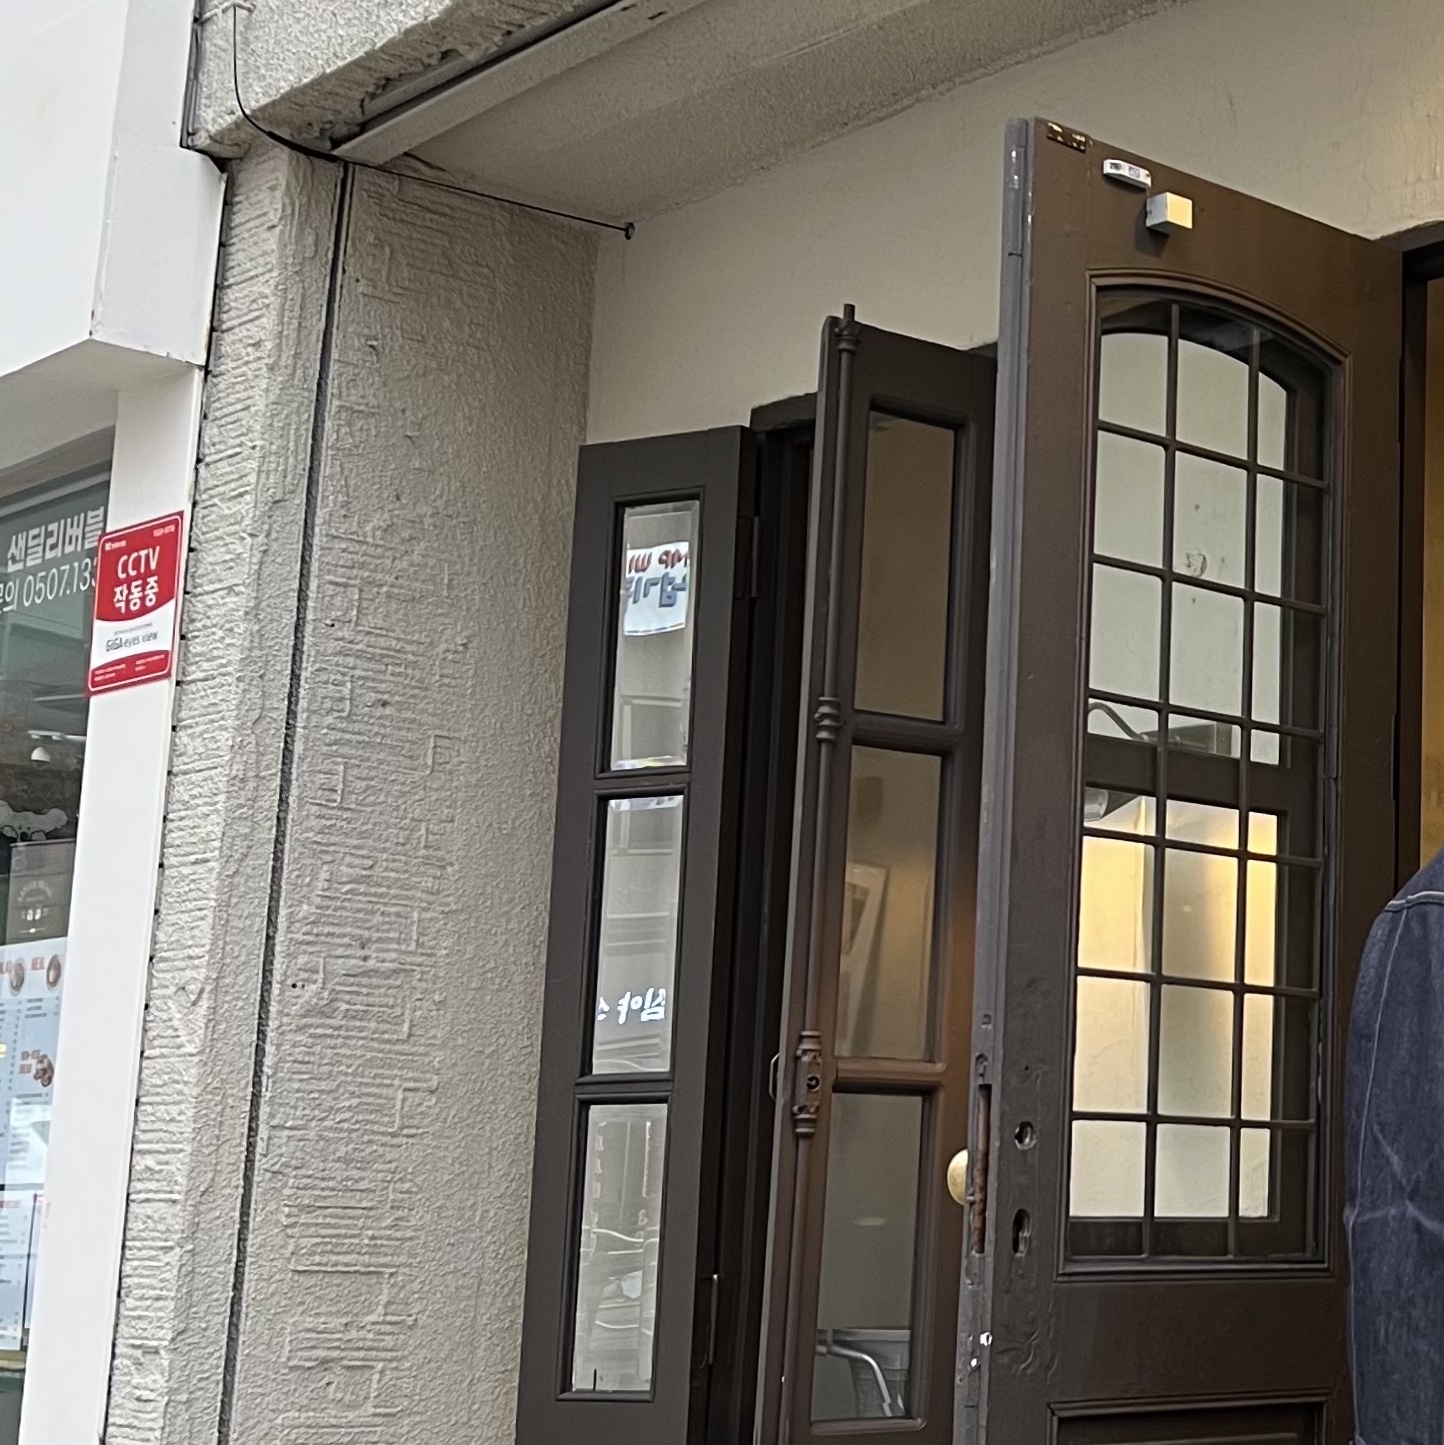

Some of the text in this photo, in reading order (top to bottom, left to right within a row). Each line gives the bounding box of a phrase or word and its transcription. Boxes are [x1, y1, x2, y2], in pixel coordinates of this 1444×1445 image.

[117, 545, 160, 579] CCTV
[0, 578, 19, 614] 의
[113, 575, 159, 613] 작동중
